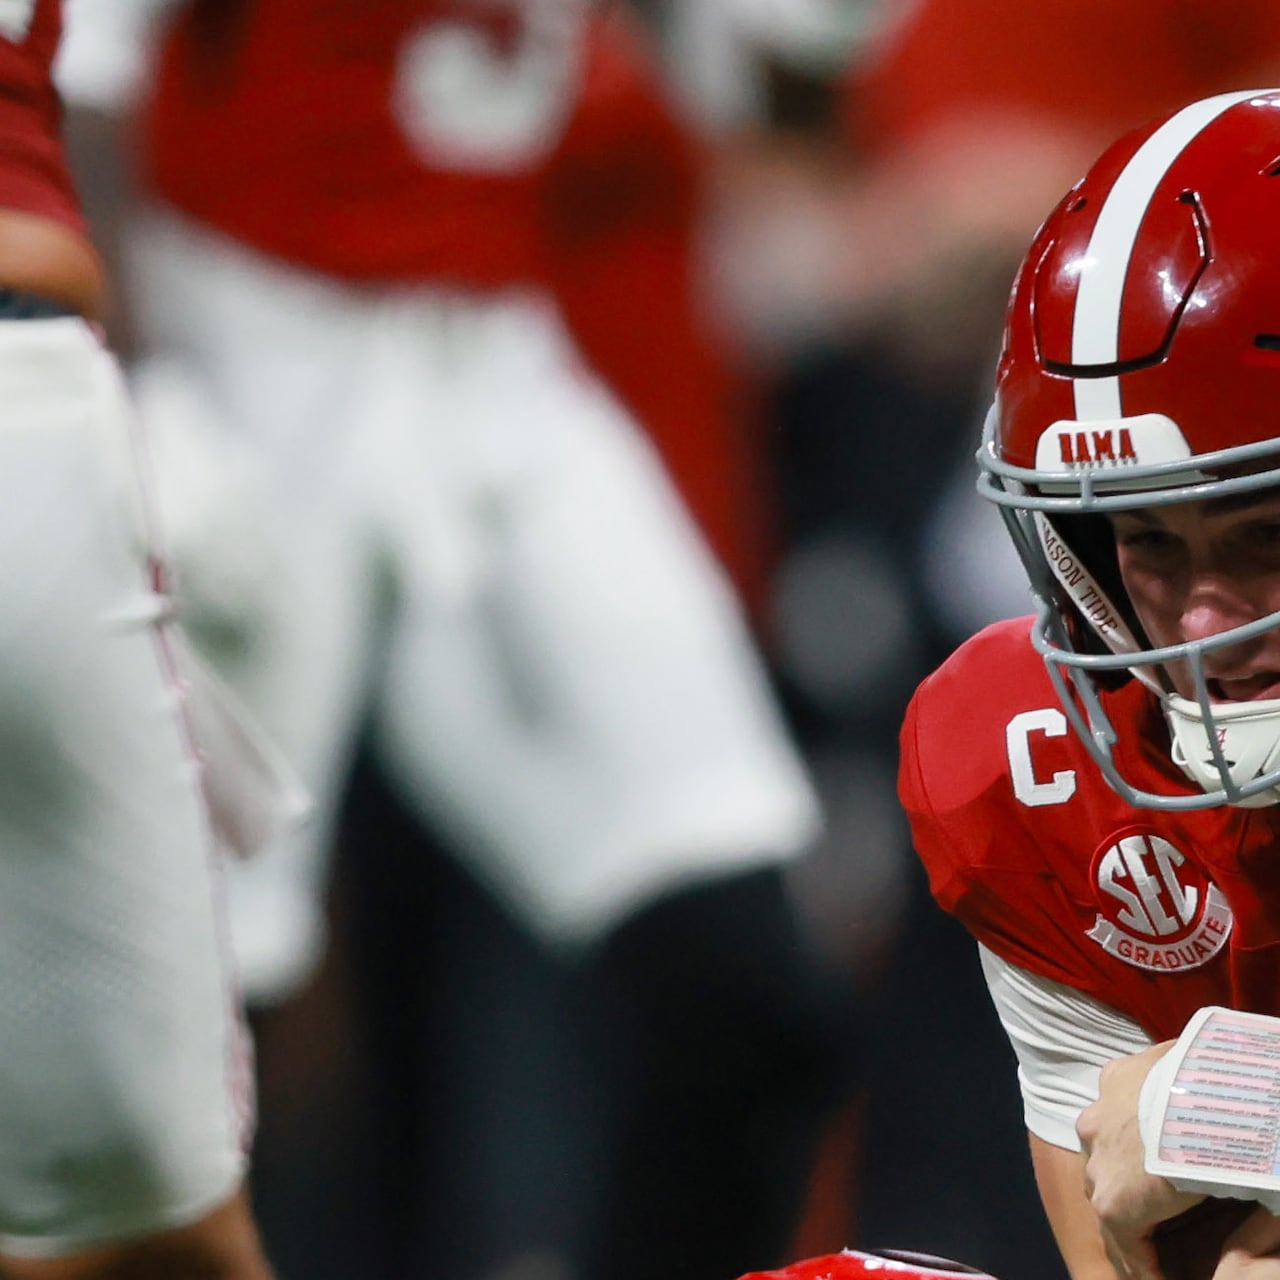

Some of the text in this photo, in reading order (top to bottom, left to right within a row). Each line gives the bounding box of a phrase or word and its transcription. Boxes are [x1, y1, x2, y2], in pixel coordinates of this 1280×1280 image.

[1080, 585, 1119, 635] TIDE
[1006, 708, 1077, 807] C
[1098, 835, 1199, 937] SEC
[1116, 917, 1227, 969] GRADUATE
